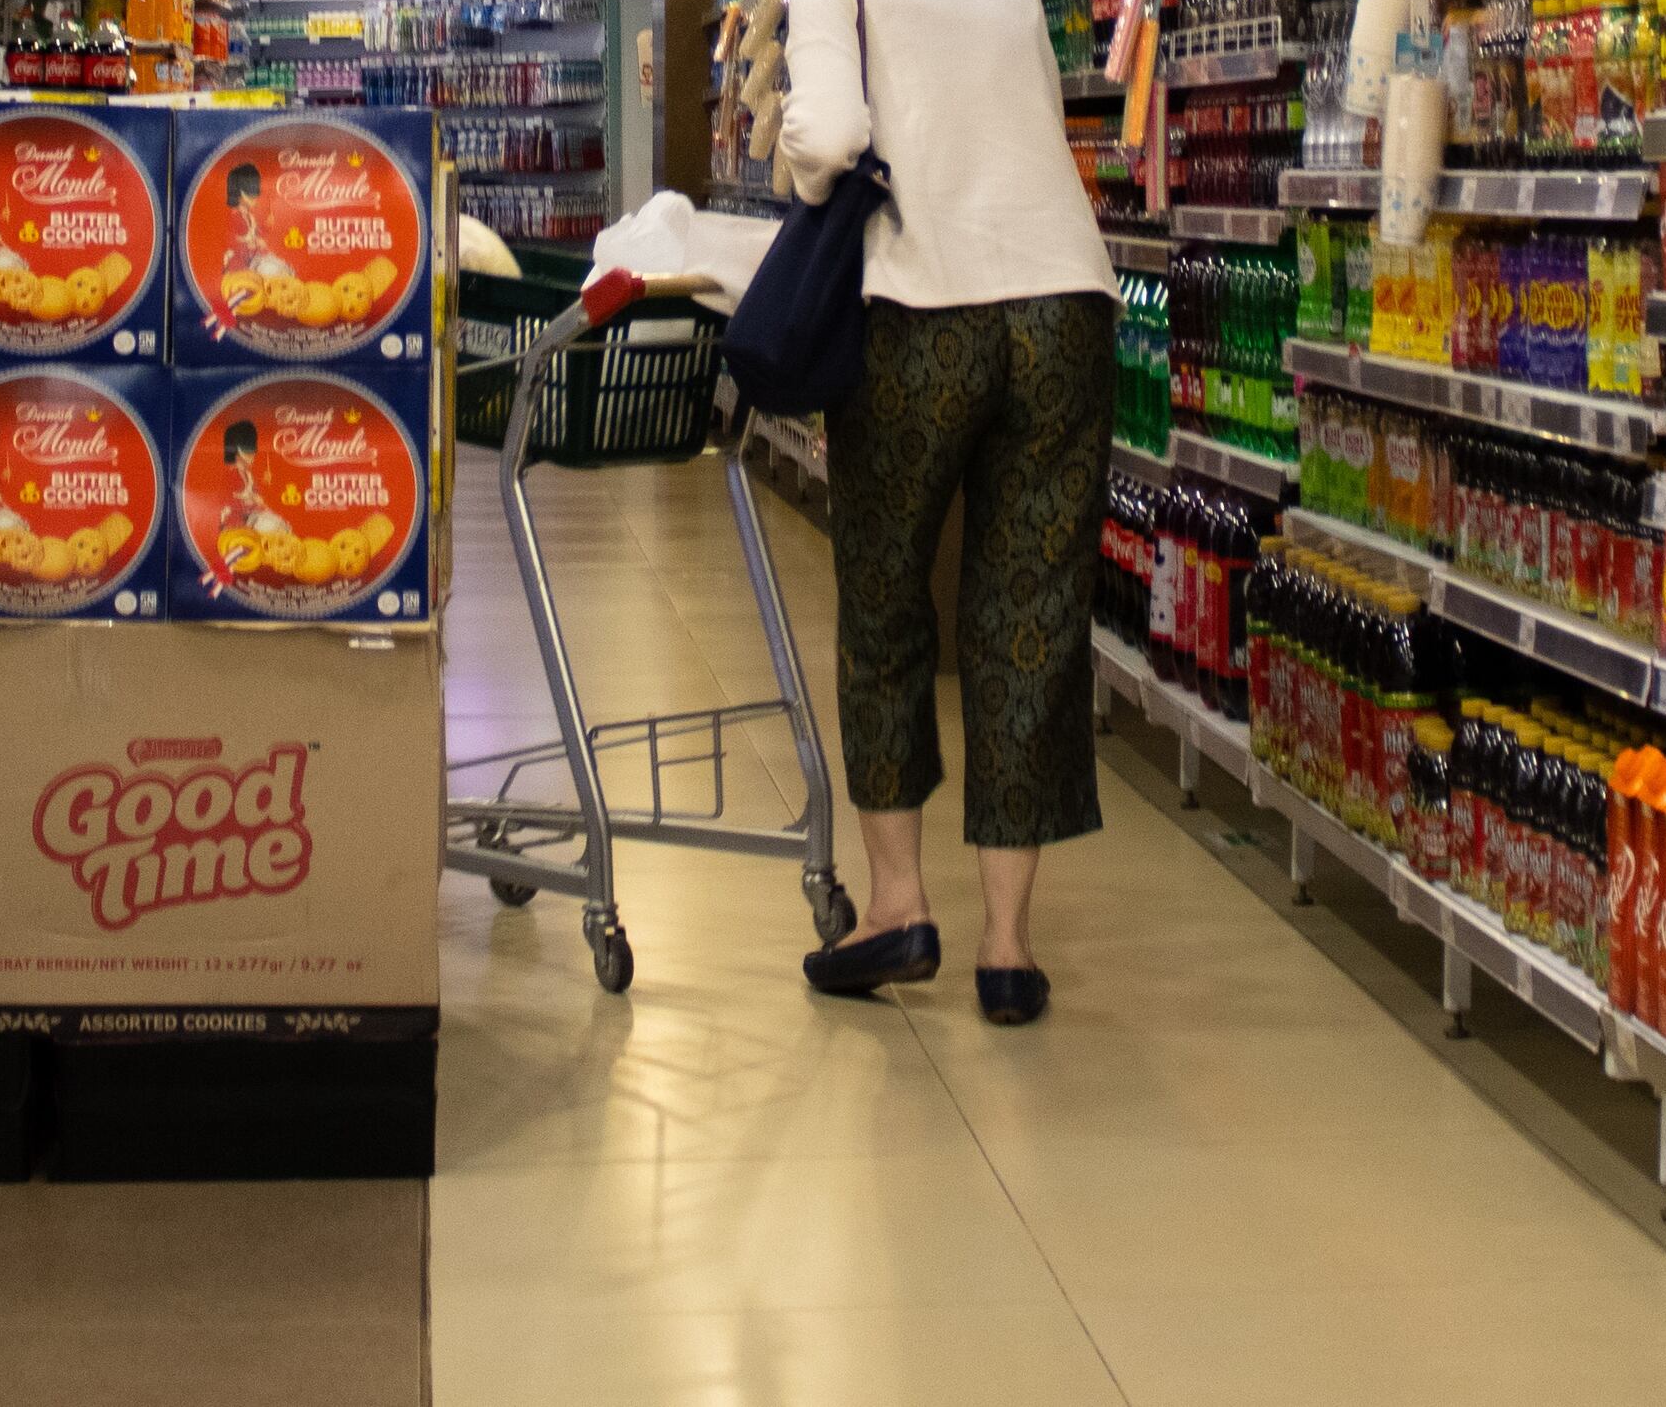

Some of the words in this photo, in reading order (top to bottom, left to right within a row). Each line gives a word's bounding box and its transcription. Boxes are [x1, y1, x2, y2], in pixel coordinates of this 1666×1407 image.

[49, 211, 120, 226] BUTTER
[314, 216, 386, 233] BUTTER
[41, 225, 128, 246] COOKIES
[306, 231, 393, 250] COOKIES
[51, 472, 122, 489] BUTTER
[311, 473, 382, 490] BUTTER
[43, 487, 129, 506] COOKIES
[304, 488, 389, 506] COOKIES
[36, 746, 304, 860] Good
[77, 824, 309, 925] Time
[79, 1013, 178, 1032] ASSORTED
[183, 1013, 267, 1032] COOKIES
